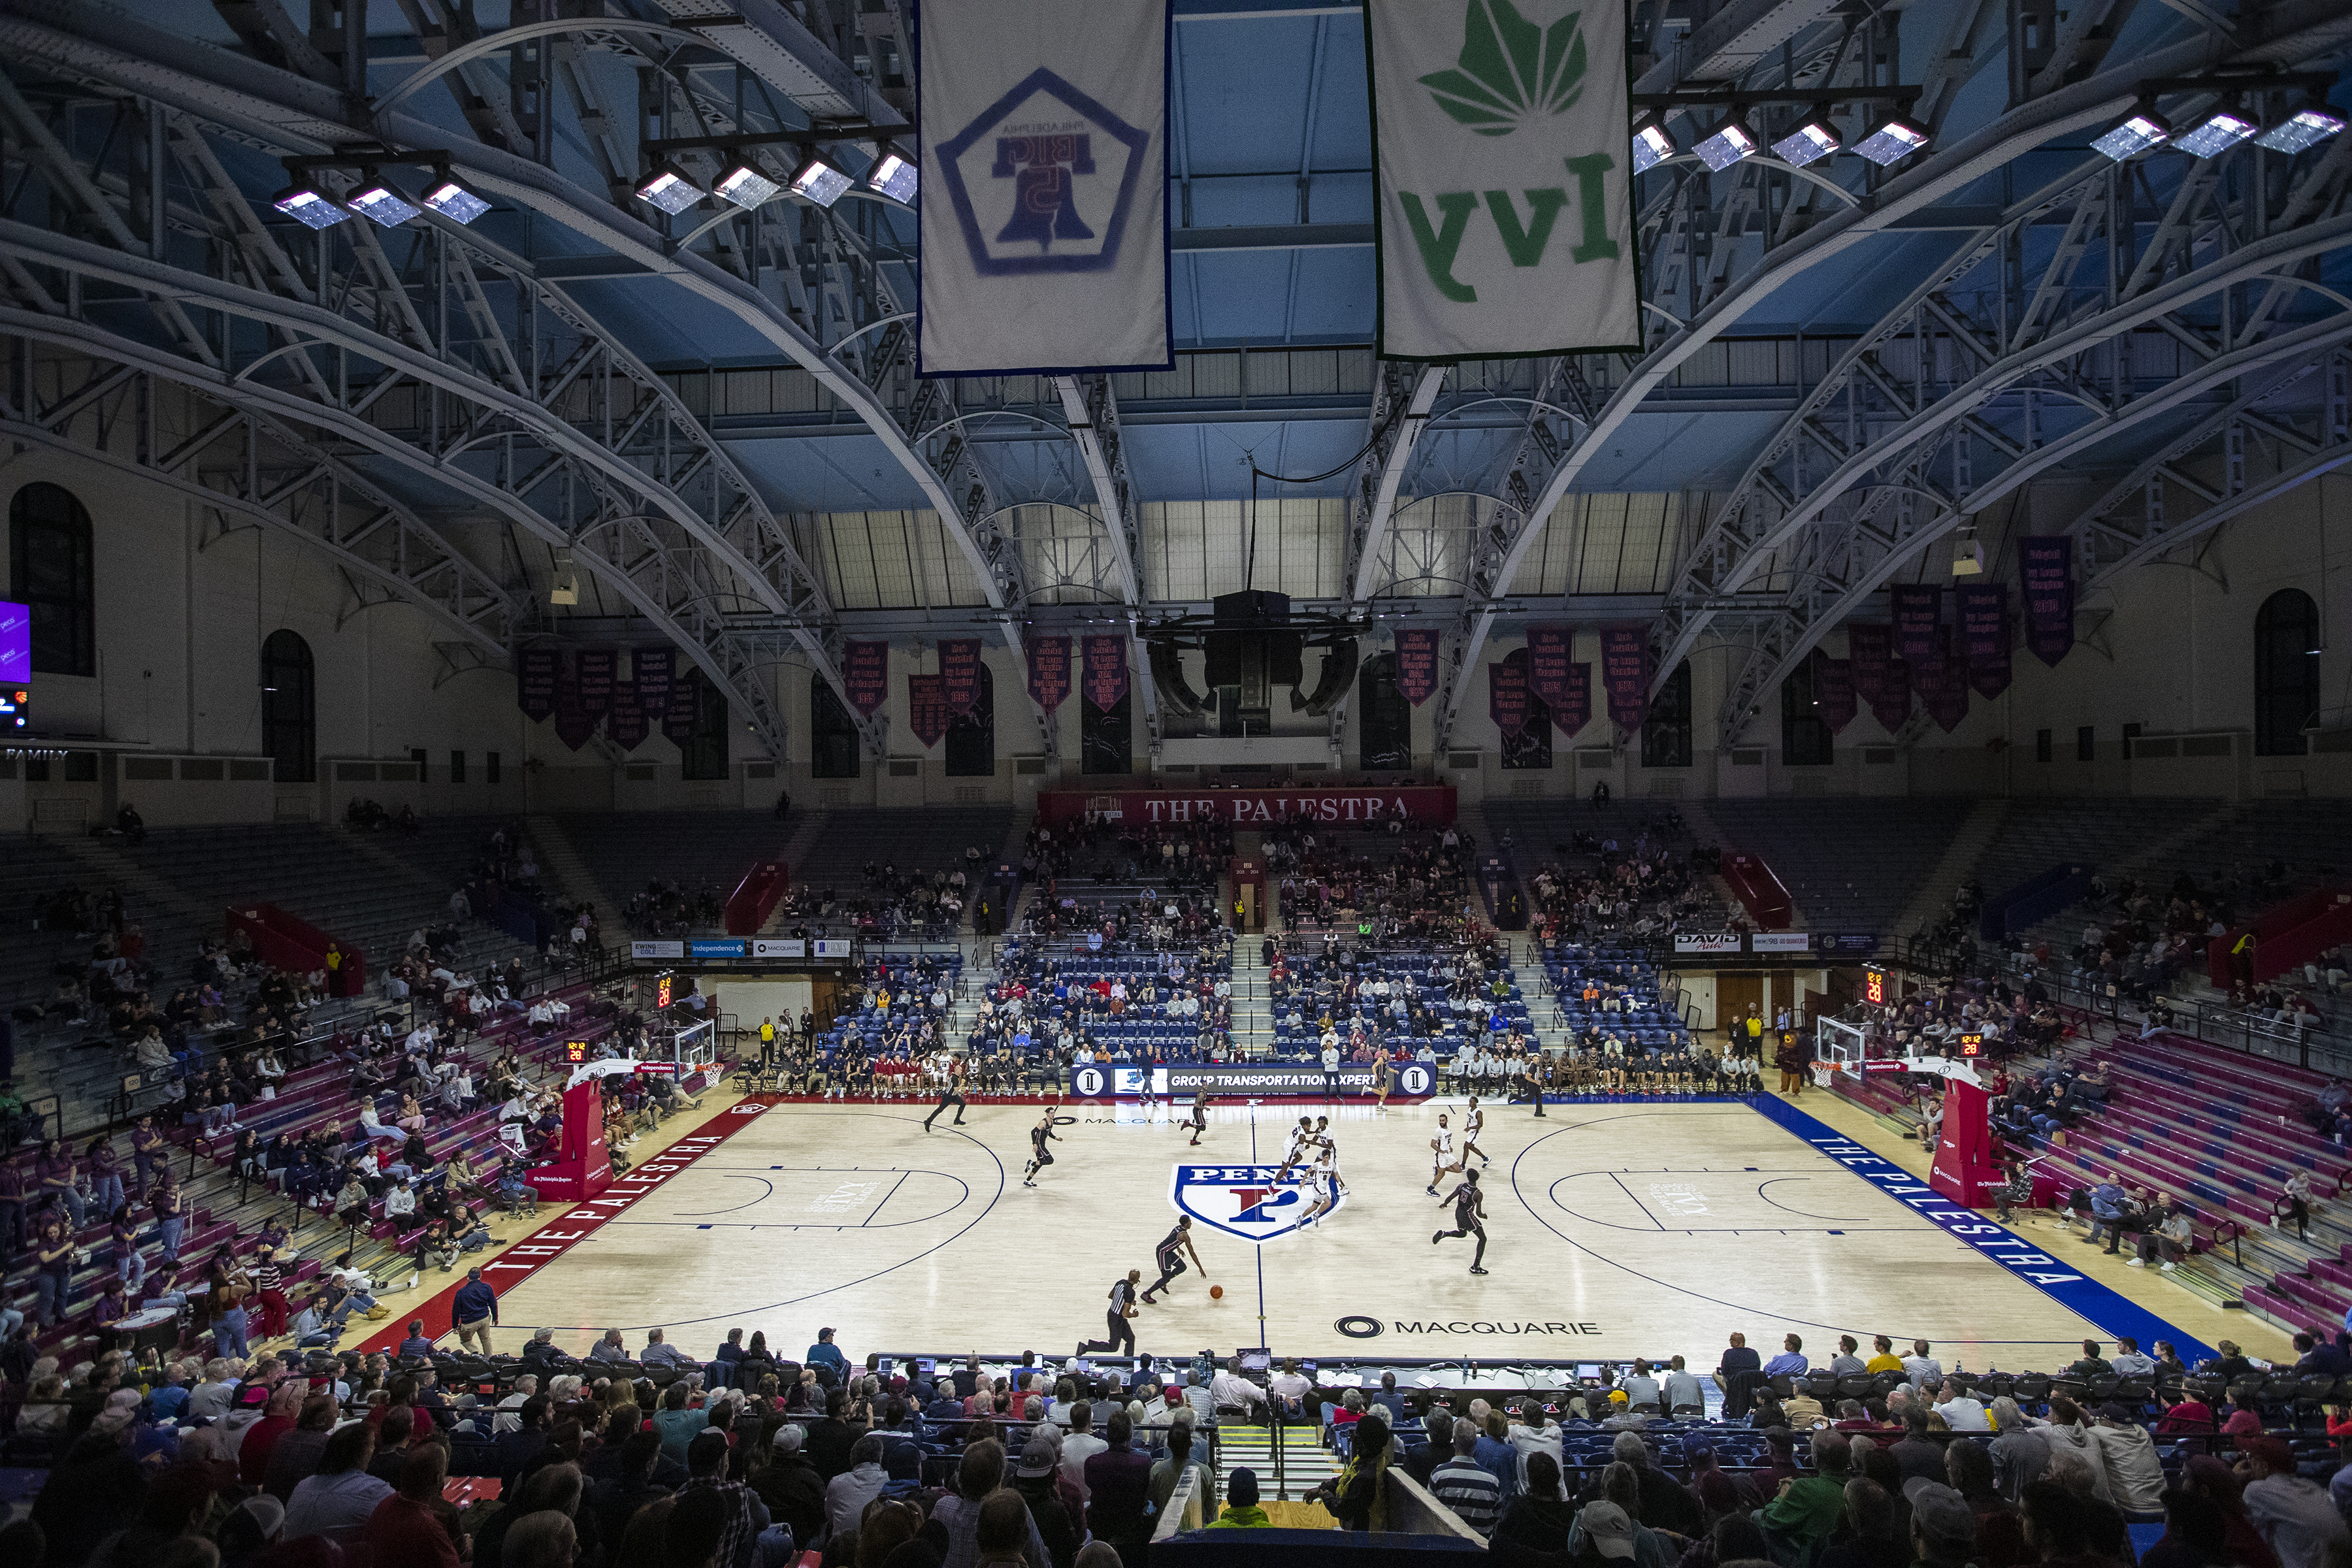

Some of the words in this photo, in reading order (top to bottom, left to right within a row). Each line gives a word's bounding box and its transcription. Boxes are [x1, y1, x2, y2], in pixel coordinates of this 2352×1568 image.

[1408, 633, 1425, 642] Men's
[952, 644, 968, 653] Men's
[1091, 645, 1117, 654] Basketball
[1403, 642, 1431, 650] Basketball
[1536, 644, 1565, 653] Basketball
[946, 655, 974, 663] Basketball
[1045, 656, 1064, 664] League
[1546, 657, 1566, 666] League
[1620, 657, 1640, 665] League
[1401, 661, 1431, 670] Champions
[1535, 668, 1565, 678] Champions
[1610, 667, 1640, 676] Champions
[946, 678, 974, 687] Champions
[1541, 681, 1561, 693] 1975
[1616, 681, 1635, 692] 1978
[951, 691, 970, 702] 1966
[1409, 687, 1425, 697] 1979
[857, 693, 875, 704] 1955
[1042, 694, 1058, 704] 1971
[1097, 693, 1114, 703] 1972
[6, 748, 69, 760] FAMILY
[1145, 800, 1215, 823] THE
[1232, 796, 1408, 821] PALESTRA
[1677, 934, 1739, 943] DAVID
[1695, 940, 1724, 951] Auto
[659, 987, 670, 1007] 28
[1868, 982, 1882, 1002] 28
[1962, 1035, 1981, 1043] 12:12
[568, 1042, 585, 1051] 12:12
[1964, 1044, 1977, 1054] 28
[570, 1050, 582, 1060] 28
[1171, 1075, 1215, 1086] GROUP
[1217, 1074, 1327, 1086] TRANSPORTATION
[1330, 1074, 1386, 1085] EXPERT
[1810, 1137, 1886, 1166] THE
[1939, 1170, 1961, 1186] MACQUARIE
[824, 1181, 866, 1203] IVY
[851, 1181, 881, 1204] LEAGUE
[484, 1230, 585, 1271] THE
[564, 1135, 723, 1220] PALESTRA
[1649, 1192, 1686, 1217] LEAGUE
[1663, 1192, 1716, 1217] IVY
[1865, 1173, 2083, 1284] PALESTRA
[1395, 1321, 1603, 1335] MACQUARIE
